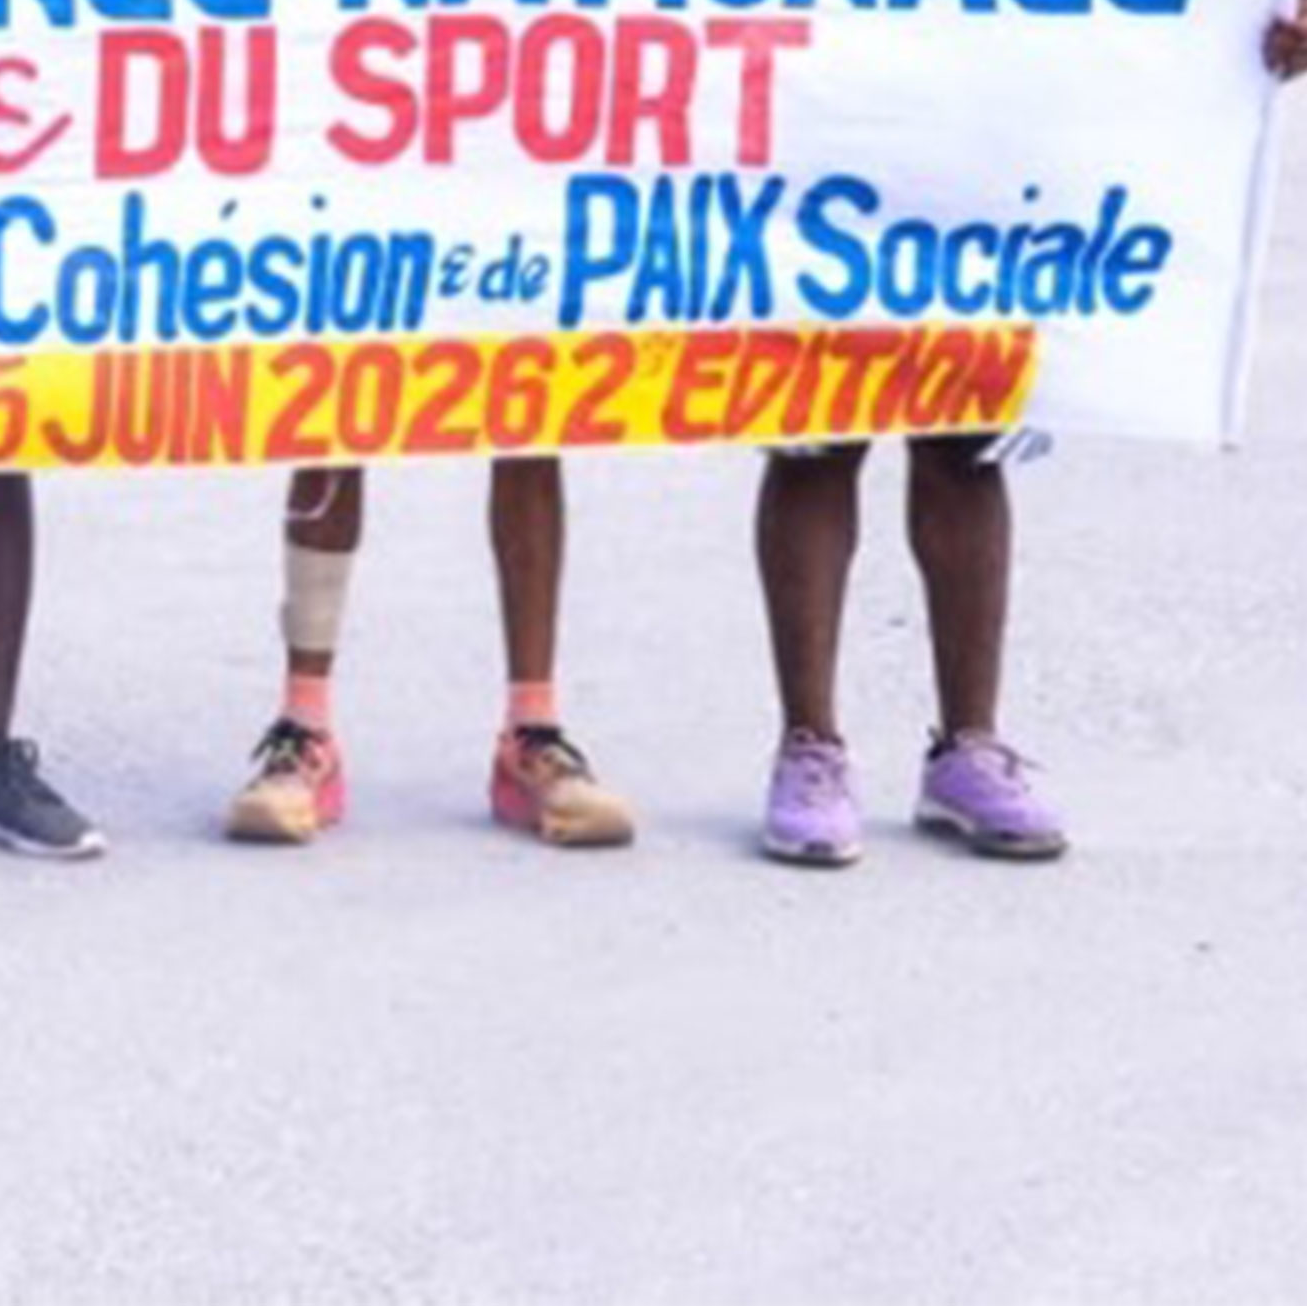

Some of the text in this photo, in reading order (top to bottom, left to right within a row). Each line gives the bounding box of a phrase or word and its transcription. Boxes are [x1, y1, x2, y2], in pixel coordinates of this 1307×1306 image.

[94, 25, 278, 179] DU
[326, 13, 810, 166] SPORT
[478, 233, 551, 304] de
[558, 173, 785, 328] PAIX
[795, 173, 1172, 320] Sociale
[46, 346, 252, 465] JUIN
[264, 338, 556, 460] 2026
[663, 328, 1034, 444] EDITION
